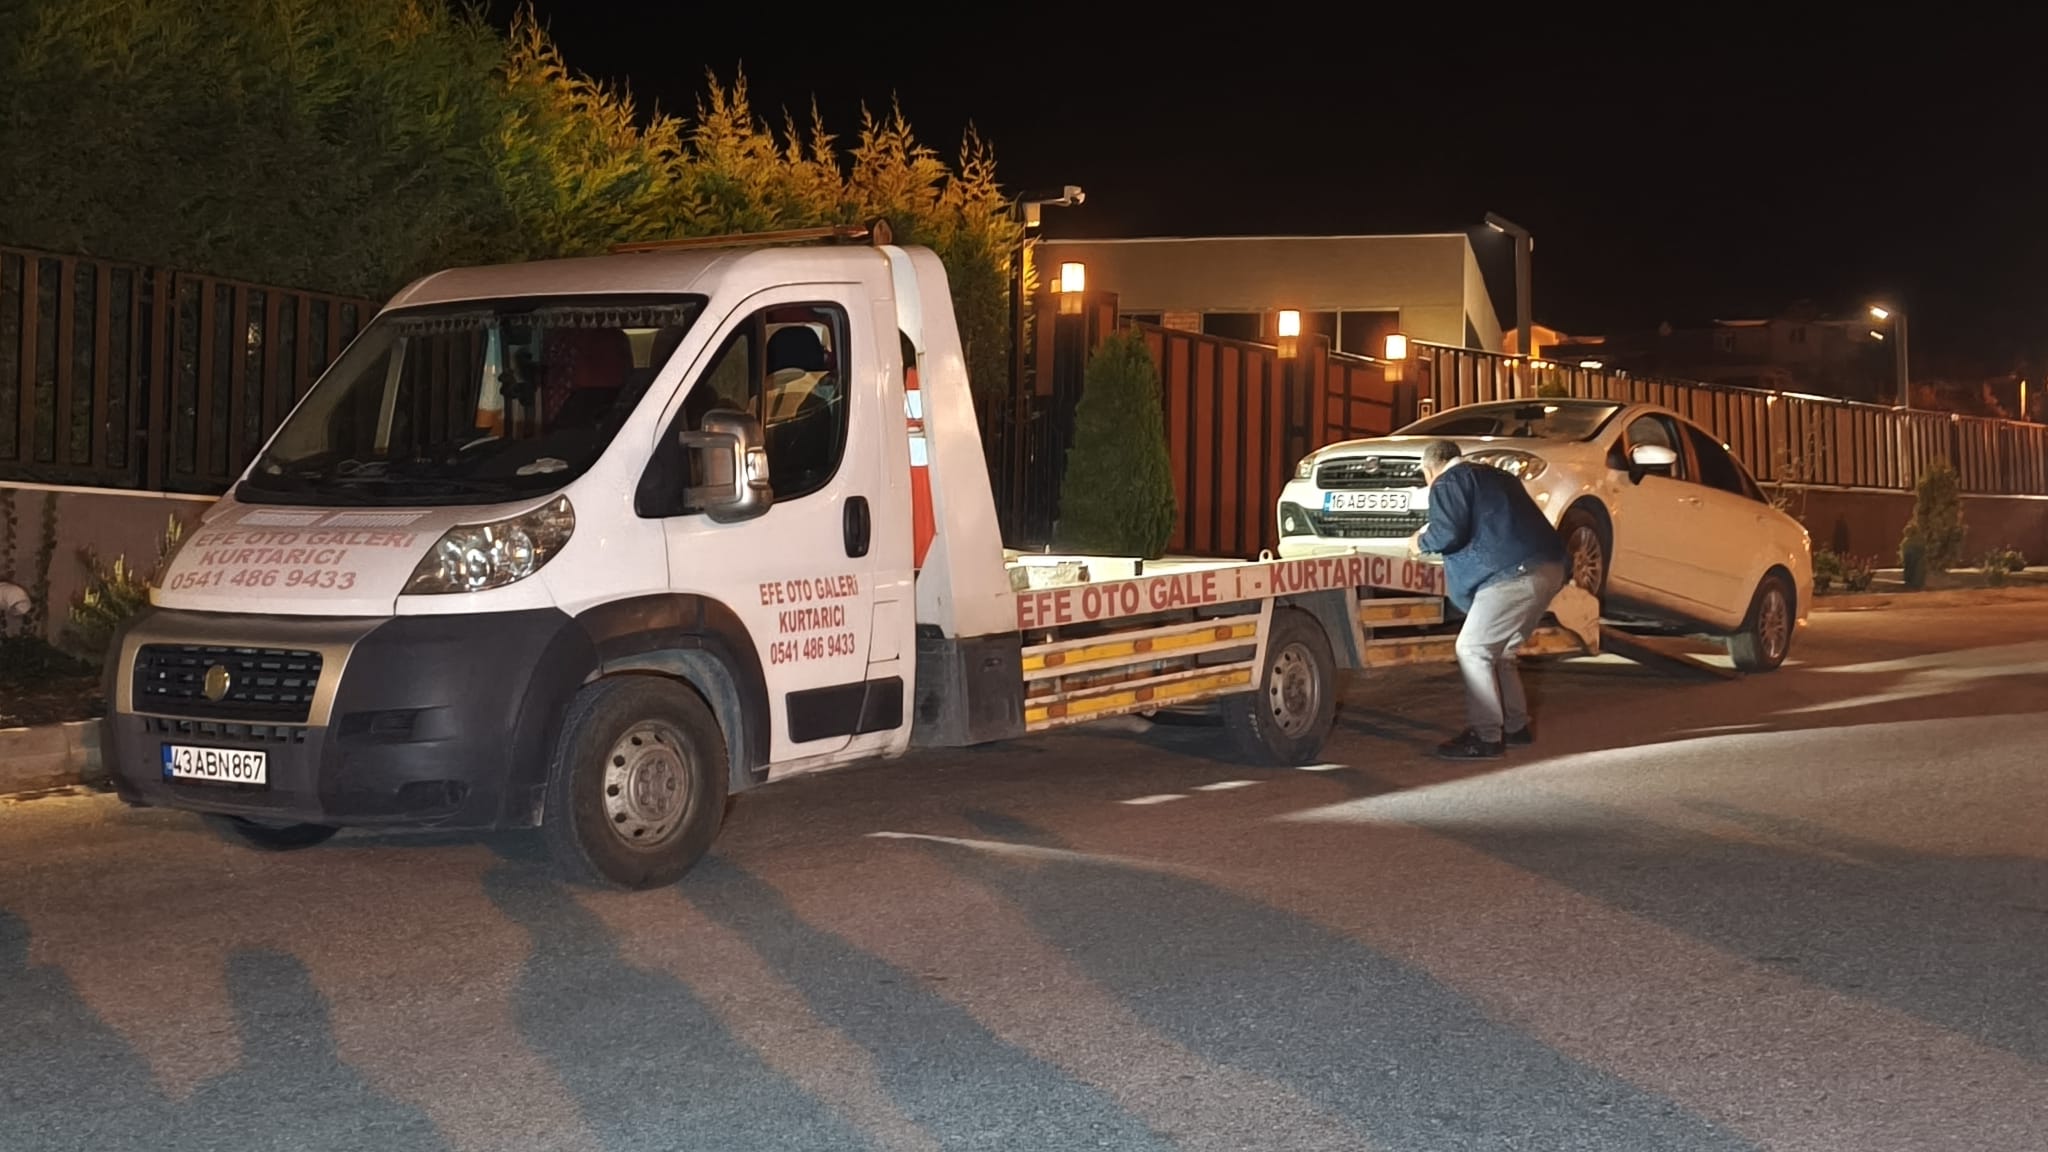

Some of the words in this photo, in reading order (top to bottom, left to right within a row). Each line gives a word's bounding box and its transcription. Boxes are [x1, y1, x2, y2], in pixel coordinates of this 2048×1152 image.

[195, 532, 238, 547] EFE
[245, 532, 297, 546] OTO
[170, 570, 224, 590] 0541
[230, 569, 277, 587] 486
[285, 570, 357, 590] 9433
[759, 582, 785, 606] EFE
[786, 578, 813, 602] OTO
[1017, 590, 1072, 628] EFE
[1082, 582, 1139, 619] OTO
[1270, 556, 1392, 594] KURTARICI
[779, 605, 845, 634] KURTARICI
[770, 640, 799, 665] 0541
[803, 636, 824, 660] 486
[828, 632, 855, 656] 9433
